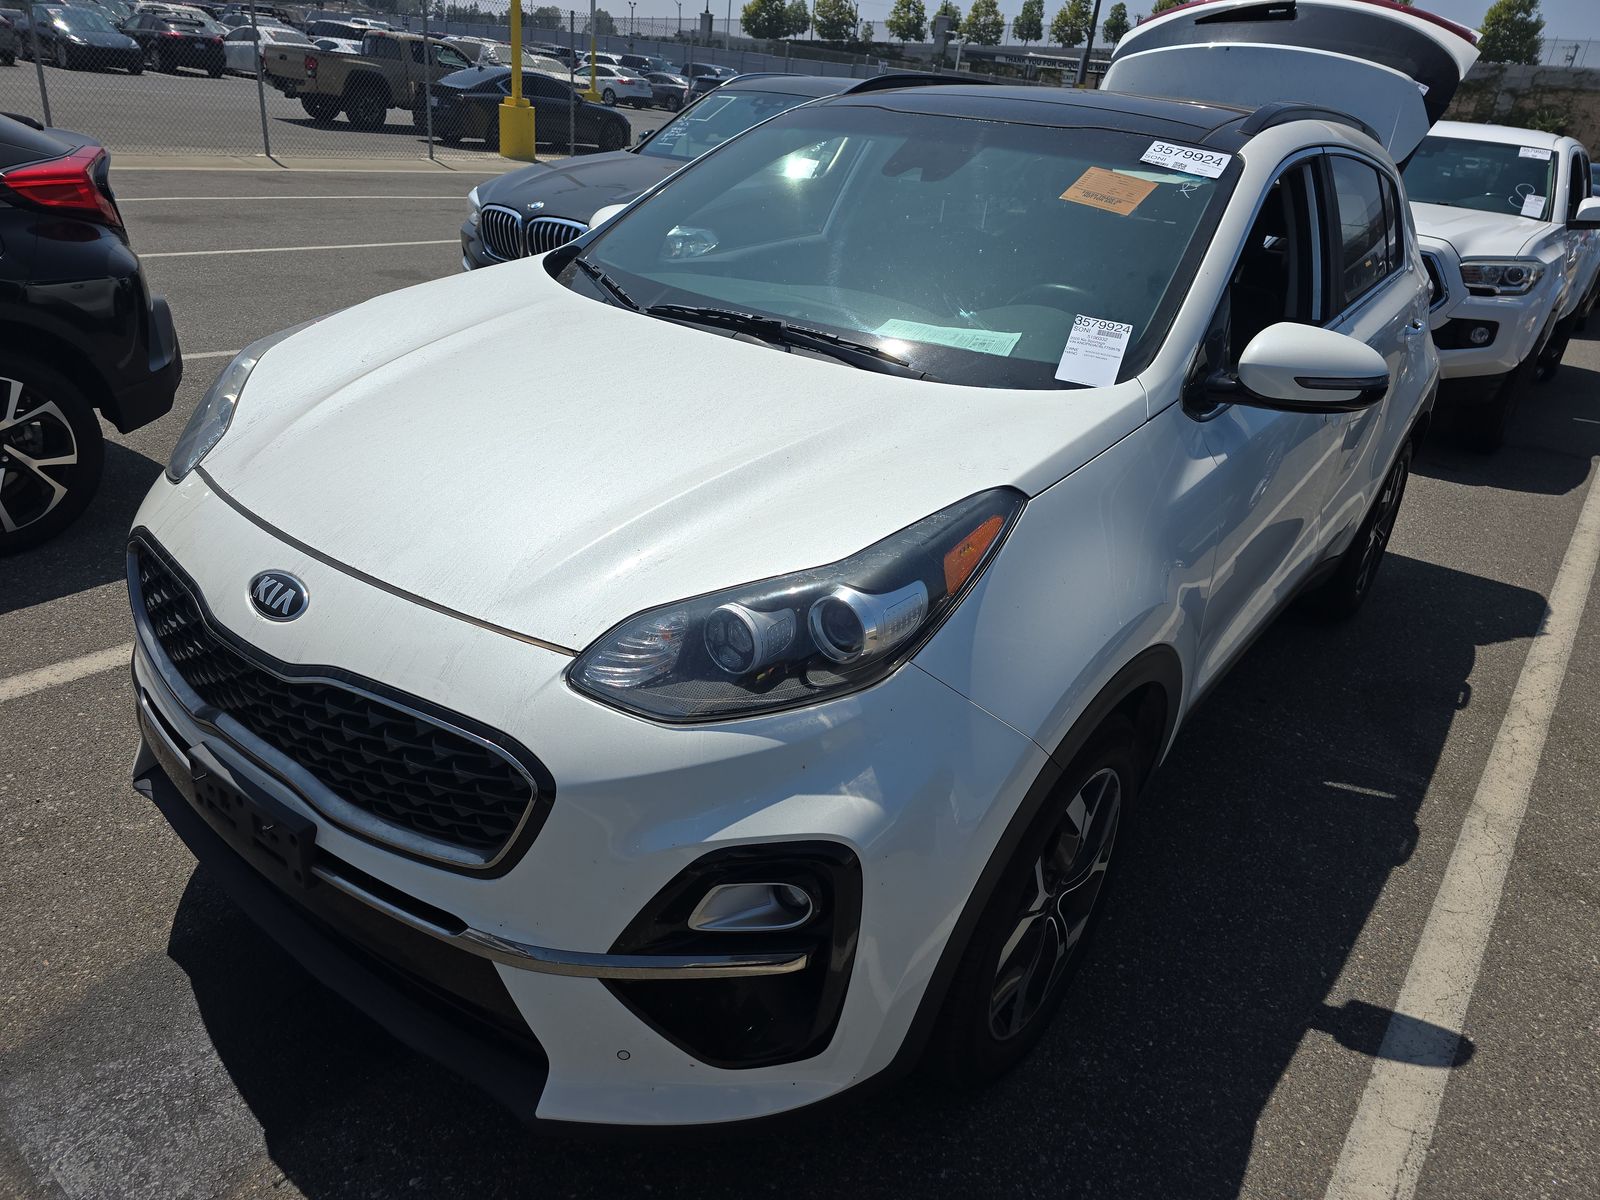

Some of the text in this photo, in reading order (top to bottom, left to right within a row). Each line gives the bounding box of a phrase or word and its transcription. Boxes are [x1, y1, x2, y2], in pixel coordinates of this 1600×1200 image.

[1153, 144, 1224, 166] 3579924
[1074, 316, 1130, 334] 3579924
[253, 576, 296, 614] KIA
